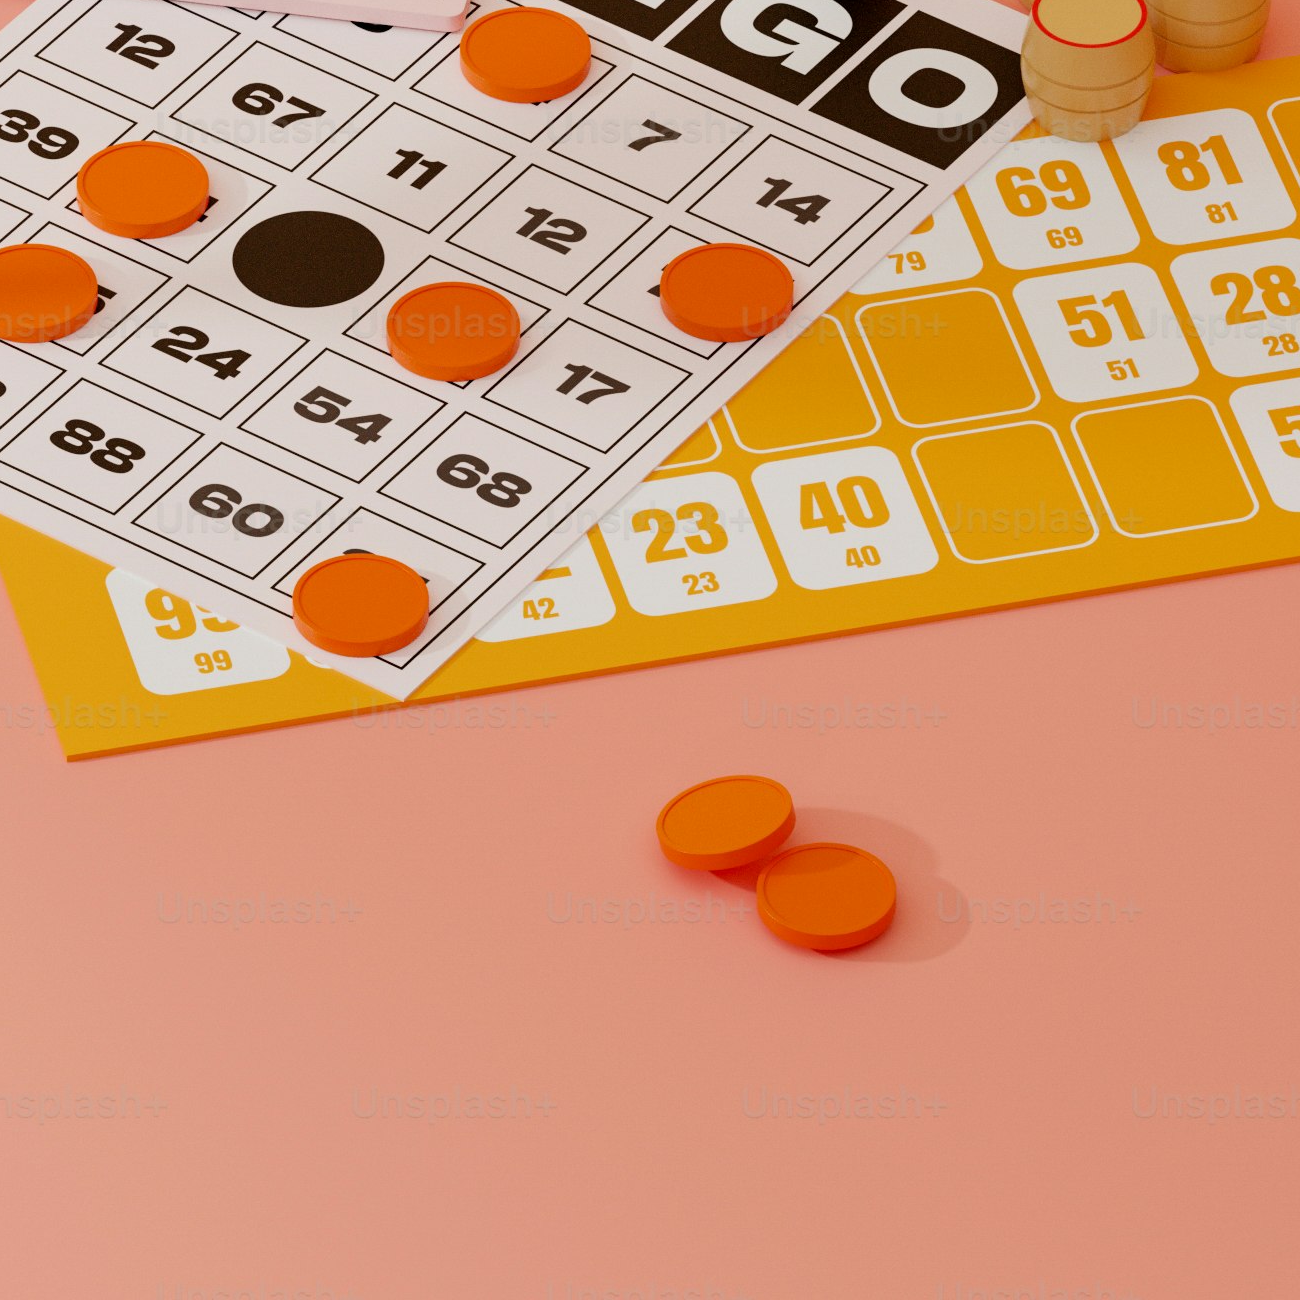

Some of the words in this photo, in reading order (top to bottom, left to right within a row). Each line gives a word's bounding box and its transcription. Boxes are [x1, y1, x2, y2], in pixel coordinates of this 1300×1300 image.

[105, 22, 176, 70] 12
[231, 82, 327, 129] 67
[386, 148, 448, 191] 11
[515, 206, 588, 256] 12
[627, 118, 683, 152] 7
[755, 177, 832, 226] 14
[1157, 134, 1244, 192] 81
[995, 159, 1091, 218] 69
[1204, 201, 1239, 225] 81
[1045, 225, 1084, 249] 69
[887, 251, 927, 275] 79
[1056, 289, 1145, 349] 51
[1261, 332, 1300, 357] 28
[555, 363, 632, 405] 17
[1105, 357, 1140, 381] 51
[150, 325, 252, 381] 24
[293, 385, 393, 445] 54
[436, 453, 533, 509] 68
[49, 418, 146, 474] 88
[188, 483, 285, 538] 60
[799, 475, 891, 535] 40
[631, 501, 729, 564] 23
[845, 545, 881, 569] 40
[681, 571, 720, 596] 23
[522, 597, 559, 621] 42
[193, 649, 233, 675] 99
